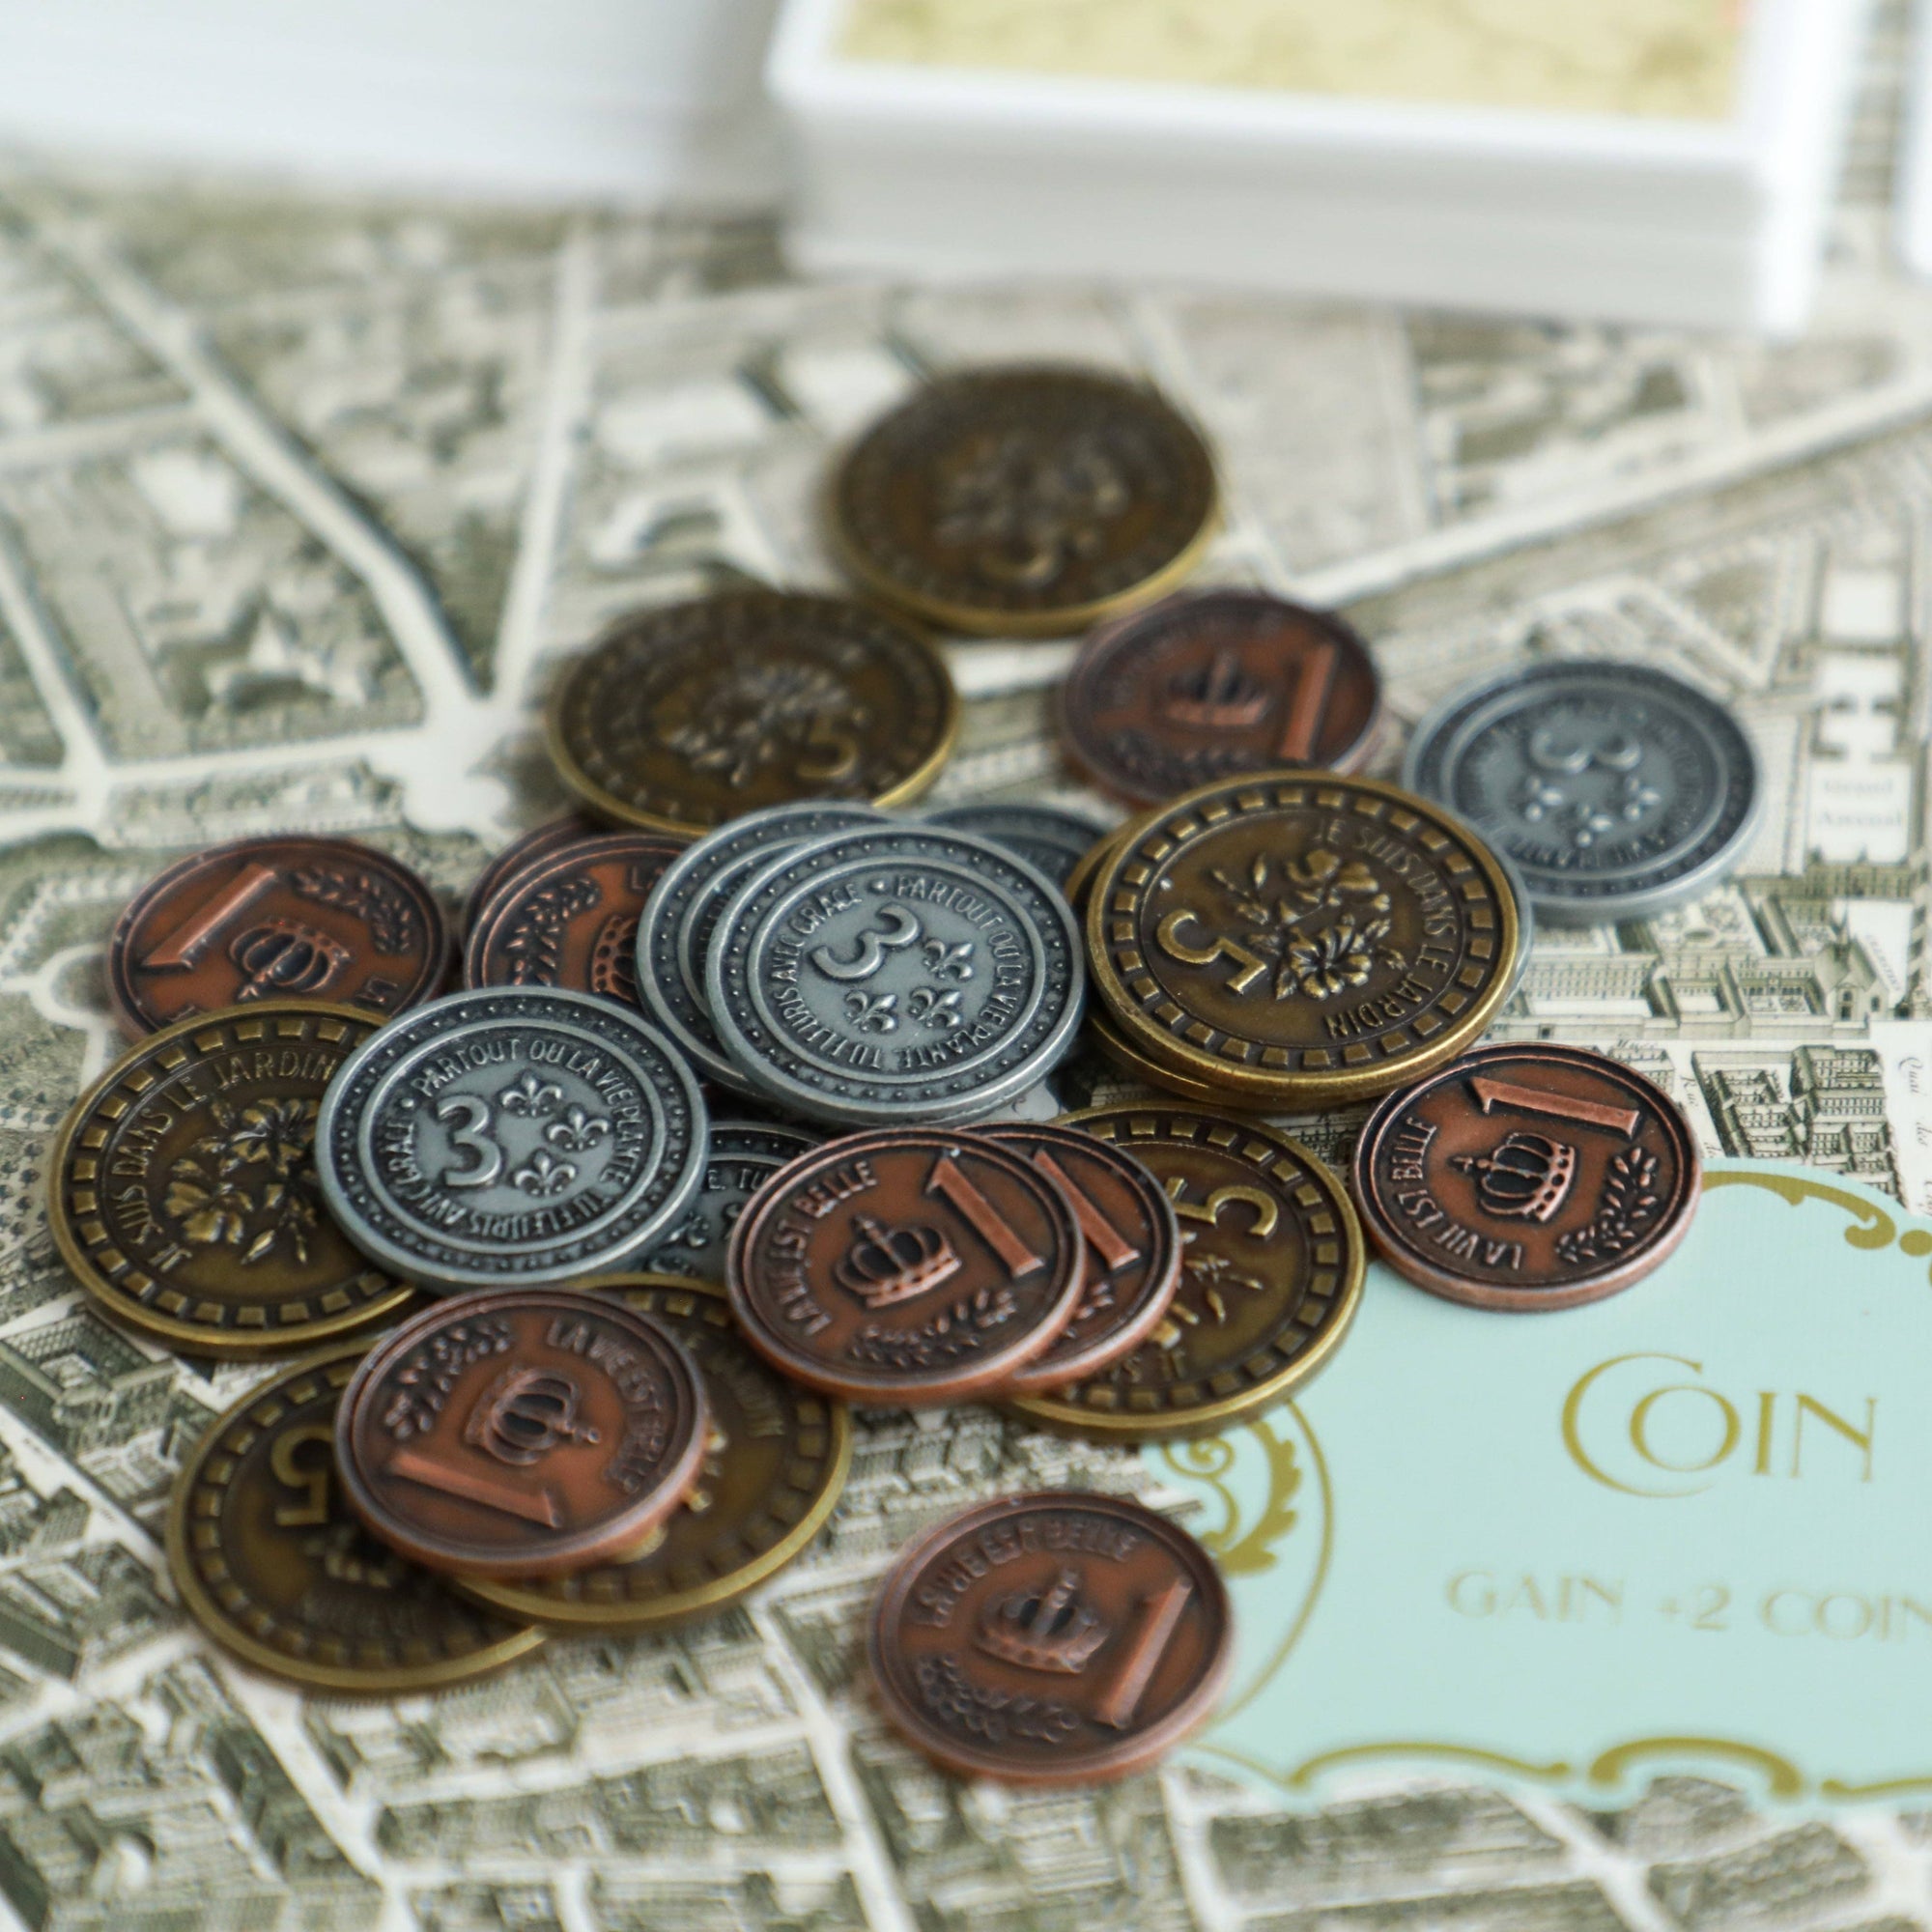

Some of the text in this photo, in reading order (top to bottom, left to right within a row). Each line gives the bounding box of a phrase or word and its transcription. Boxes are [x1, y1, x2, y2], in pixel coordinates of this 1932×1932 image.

[1279, 641, 1339, 762] 1
[794, 713, 859, 779] 5
[1530, 721, 1642, 775] 3
[142, 863, 278, 970] 1
[808, 903, 921, 980] 3
[895, 876, 1005, 930] PARTOUT
[980, 992, 1018, 1026] VIE
[1156, 908, 1267, 997] 5
[1313, 819, 1459, 1040] JE SUIS DANS LE JARDIN
[160, 1075, 209, 1112] LE
[212, 1051, 337, 1091] JARDIN
[411, 1037, 522, 1097] PARTOUT
[595, 1070, 636, 1106] VIE
[1466, 1075, 1640, 1138] 1
[110, 1108, 174, 1177] DANS
[438, 1093, 502, 1187] 3
[111, 1184, 164, 1245] SUIS
[792, 1160, 878, 1219] BELLE
[924, 1155, 1045, 1278] 1
[1034, 1147, 1141, 1271] 1
[1165, 1172, 1279, 1238] 5
[1391, 1117, 1522, 1270] LA VIE EST BELLE
[547, 1318, 589, 1354] LA
[788, 1299, 833, 1336] LA
[270, 1425, 335, 1527] 5
[391, 1449, 562, 1530] 1
[916, 1588, 960, 1629] LA
[1043, 1518, 1139, 1564] BELLE
[1445, 1569, 1626, 1625] GAIN
[1657, 1583, 1732, 1632] +2
[1097, 1575, 1196, 1729] 1
